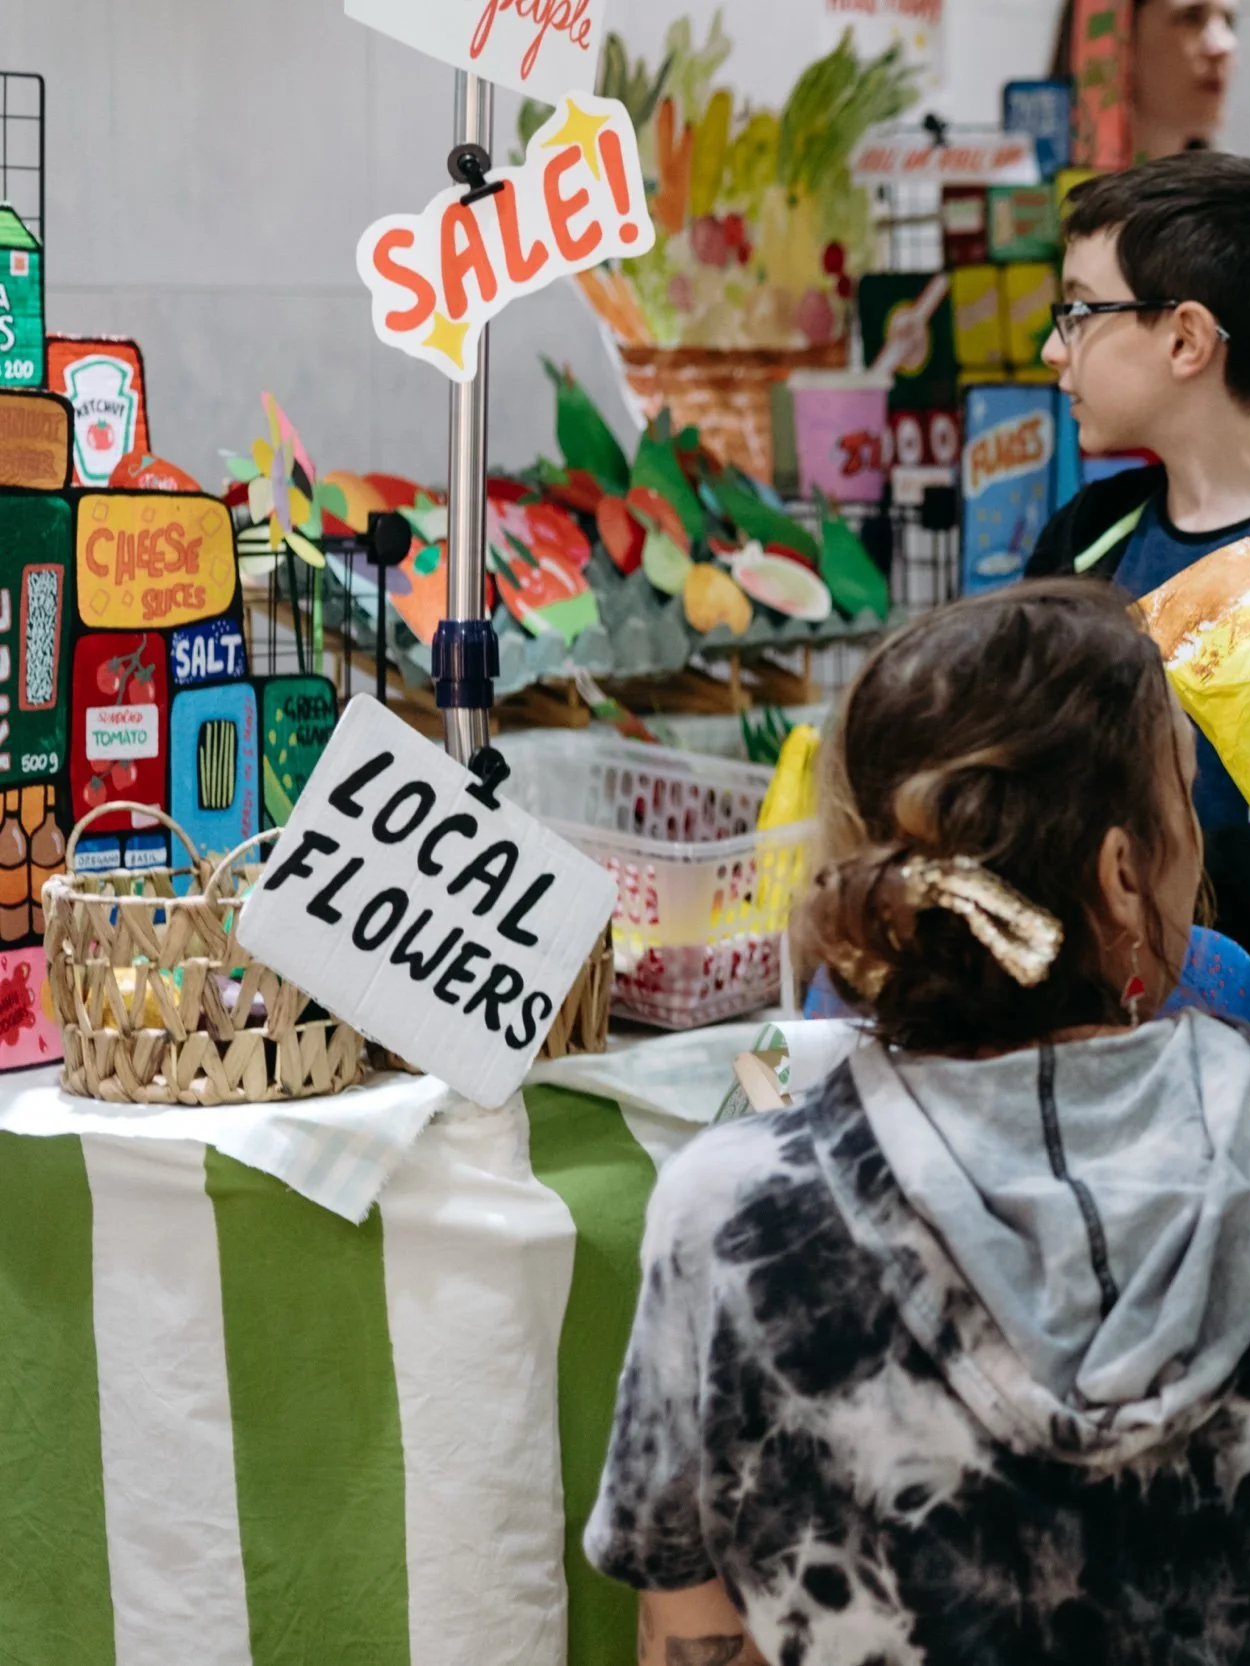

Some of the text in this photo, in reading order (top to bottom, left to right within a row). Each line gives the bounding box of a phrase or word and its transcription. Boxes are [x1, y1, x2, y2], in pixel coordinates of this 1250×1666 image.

[373, 129, 639, 332] SALE!
[970, 415, 1044, 489] FLAKES
[85, 521, 203, 586] CHEESE
[141, 583, 206, 620] SLICES
[175, 634, 242, 679] SALT
[92, 728, 147, 747] TOMATO
[328, 751, 556, 947] LOCAL
[263, 830, 553, 1050] FLOWERS
